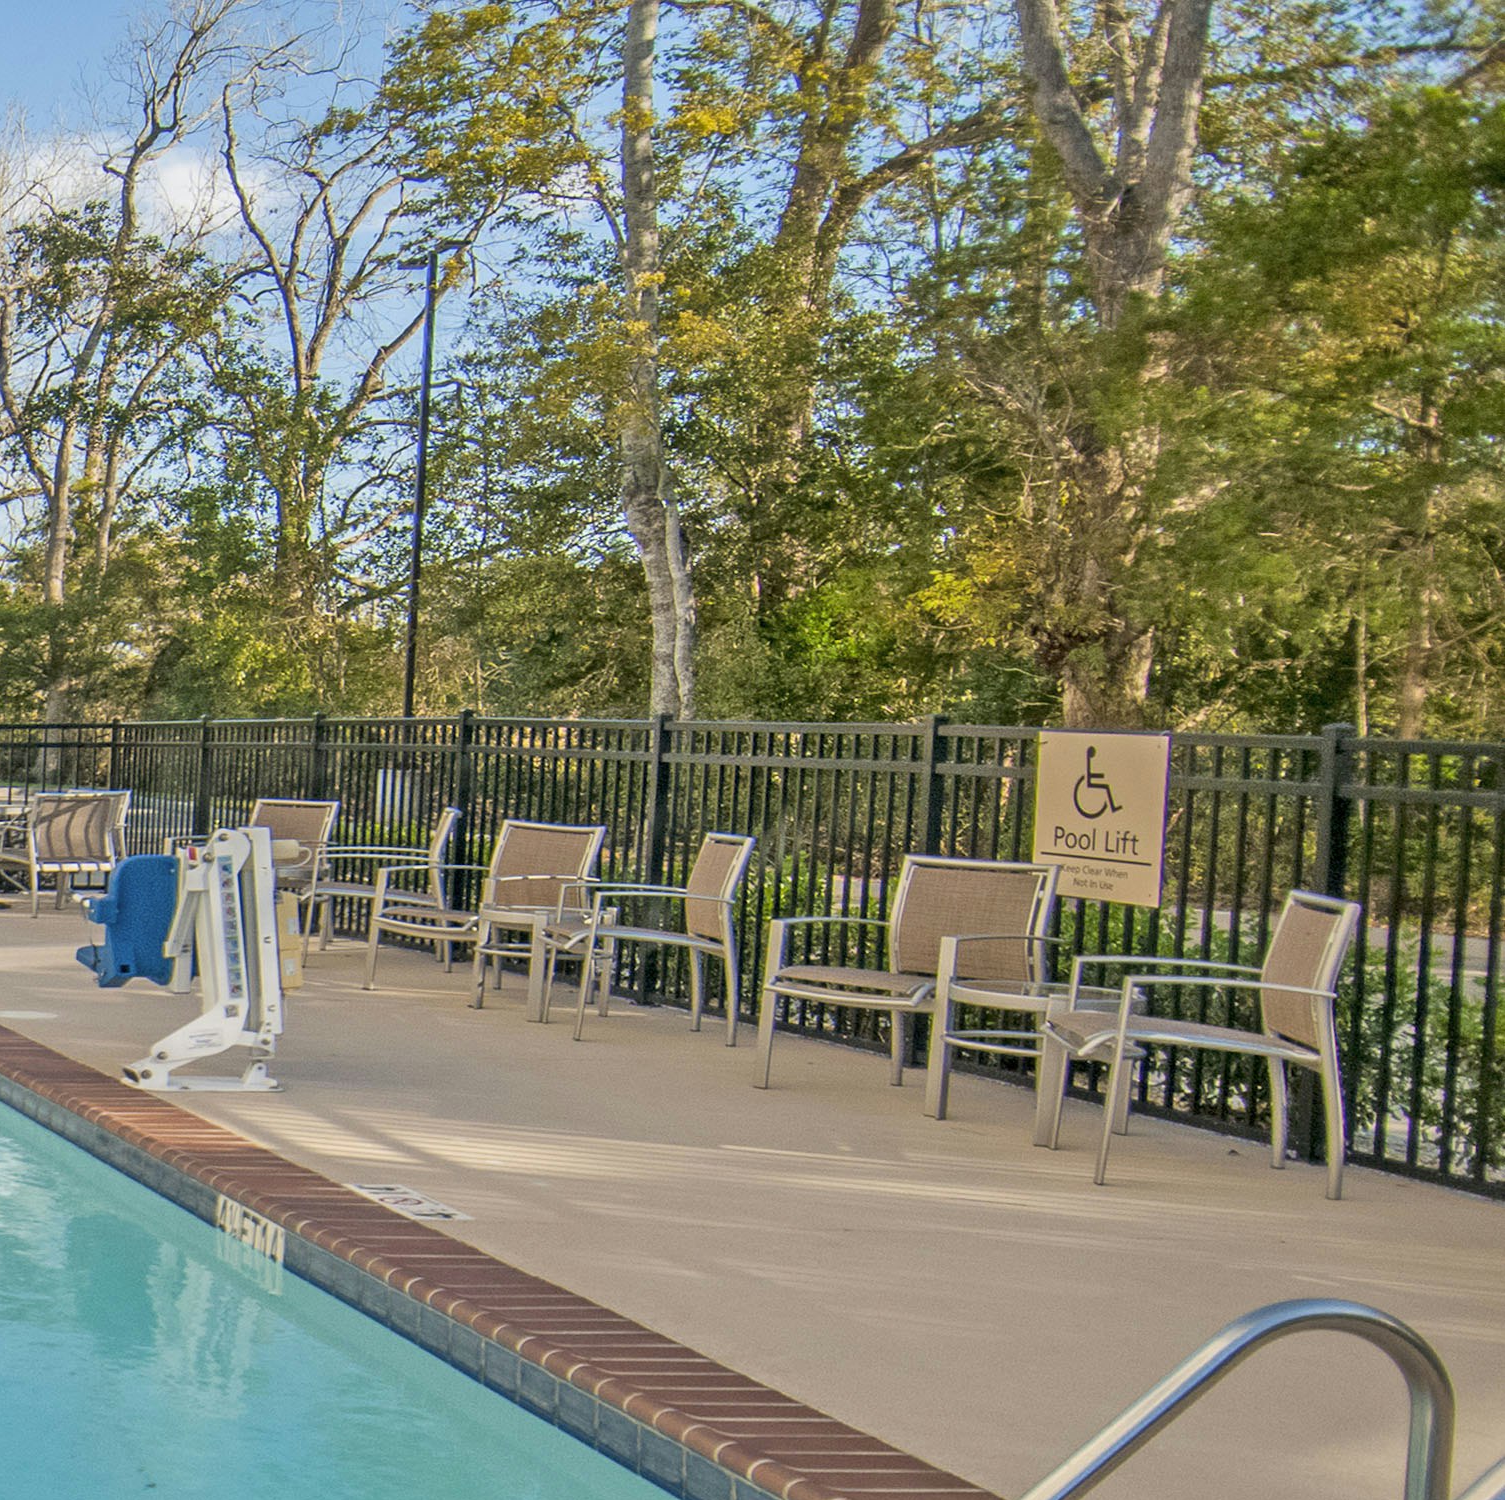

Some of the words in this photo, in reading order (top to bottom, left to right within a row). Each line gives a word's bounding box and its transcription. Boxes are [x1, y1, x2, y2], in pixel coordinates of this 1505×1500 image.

[1053, 825, 1096, 851] Pool
[1104, 829, 1139, 856] Lift
[1082, 864, 1103, 876] Clear
[1104, 867, 1129, 880] When
[1072, 877, 1088, 889] Not
[1089, 879, 1098, 889] In
[1099, 880, 1114, 892] Use
